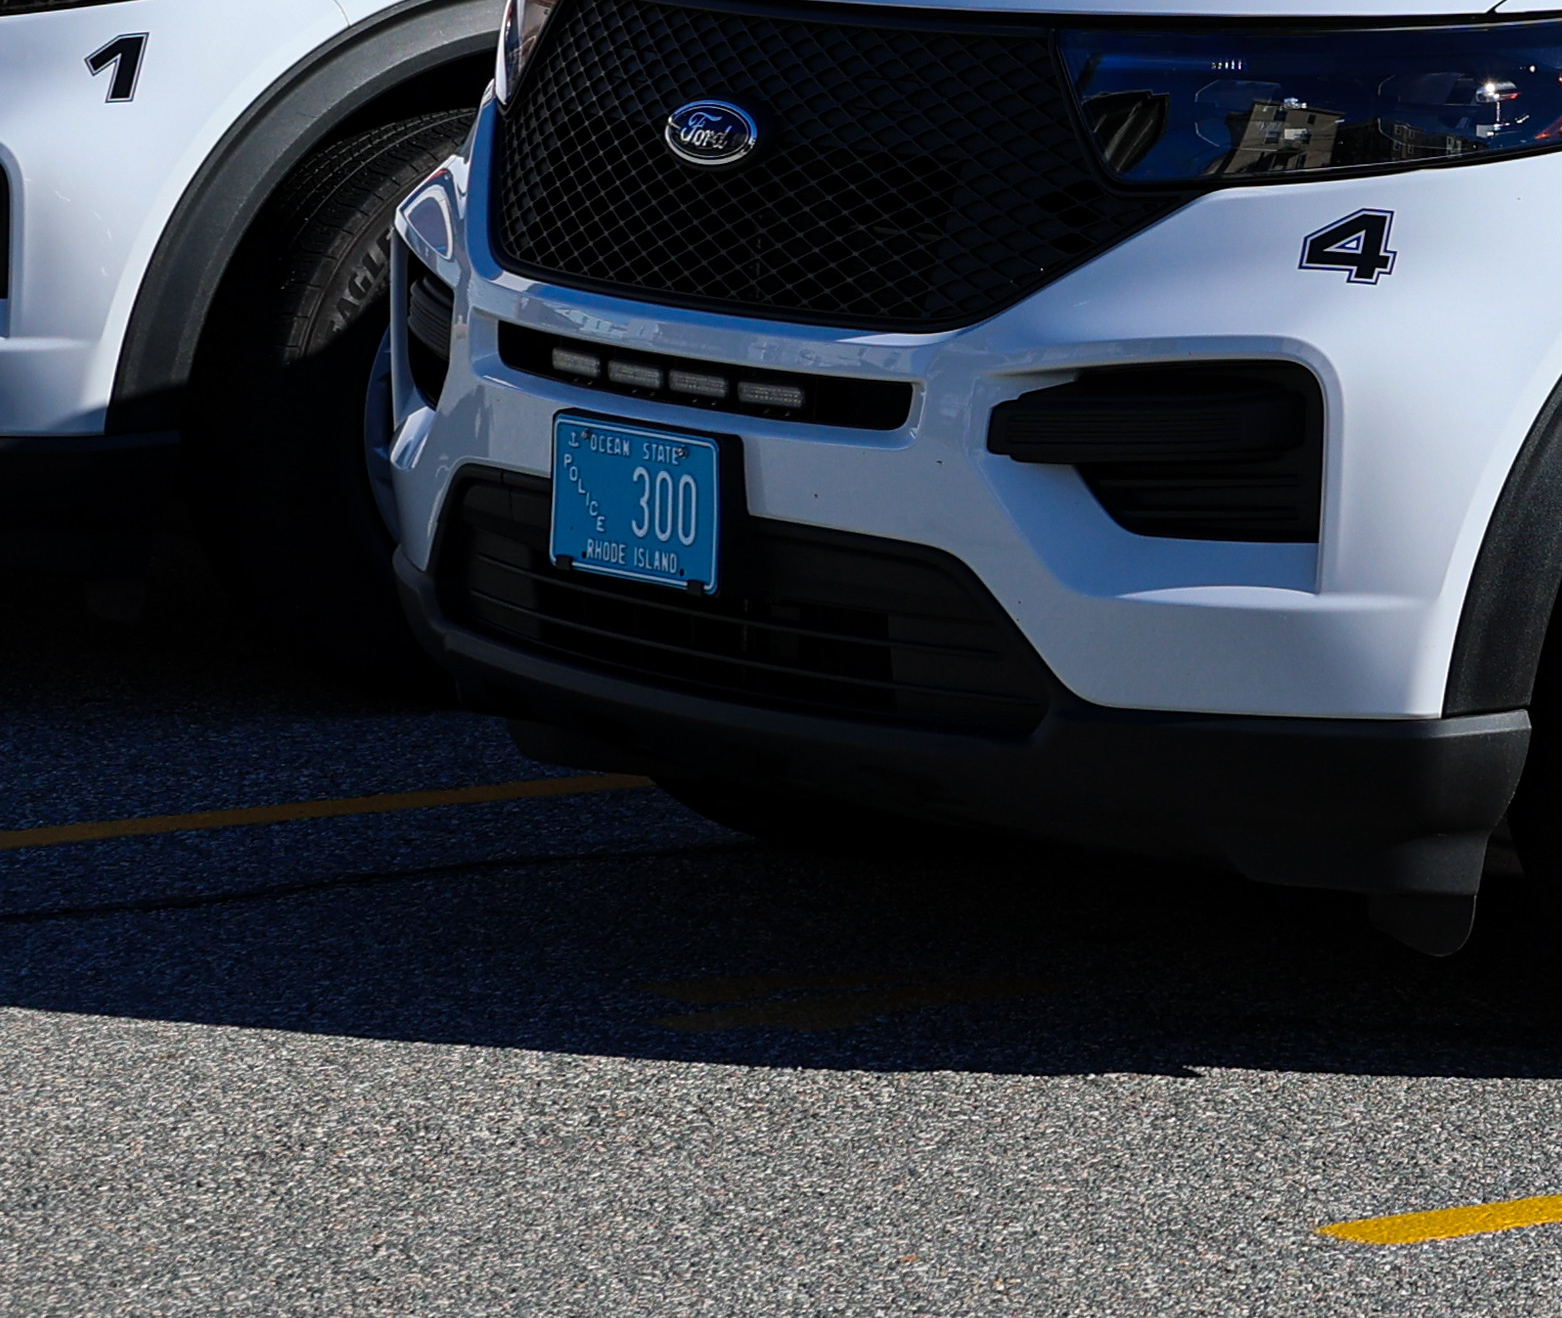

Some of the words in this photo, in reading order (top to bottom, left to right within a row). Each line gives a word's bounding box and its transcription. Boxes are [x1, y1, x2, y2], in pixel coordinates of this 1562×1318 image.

[84, 32, 150, 104] 1
[679, 110, 733, 150] Ford
[1297, 207, 1398, 286] 4
[589, 433, 631, 458] OCEAN
[643, 442, 680, 466] STATE
[563, 453, 606, 533] POLICE
[631, 465, 698, 546] 300
[586, 538, 627, 566] RHODE
[634, 545, 679, 574] ISLAND
